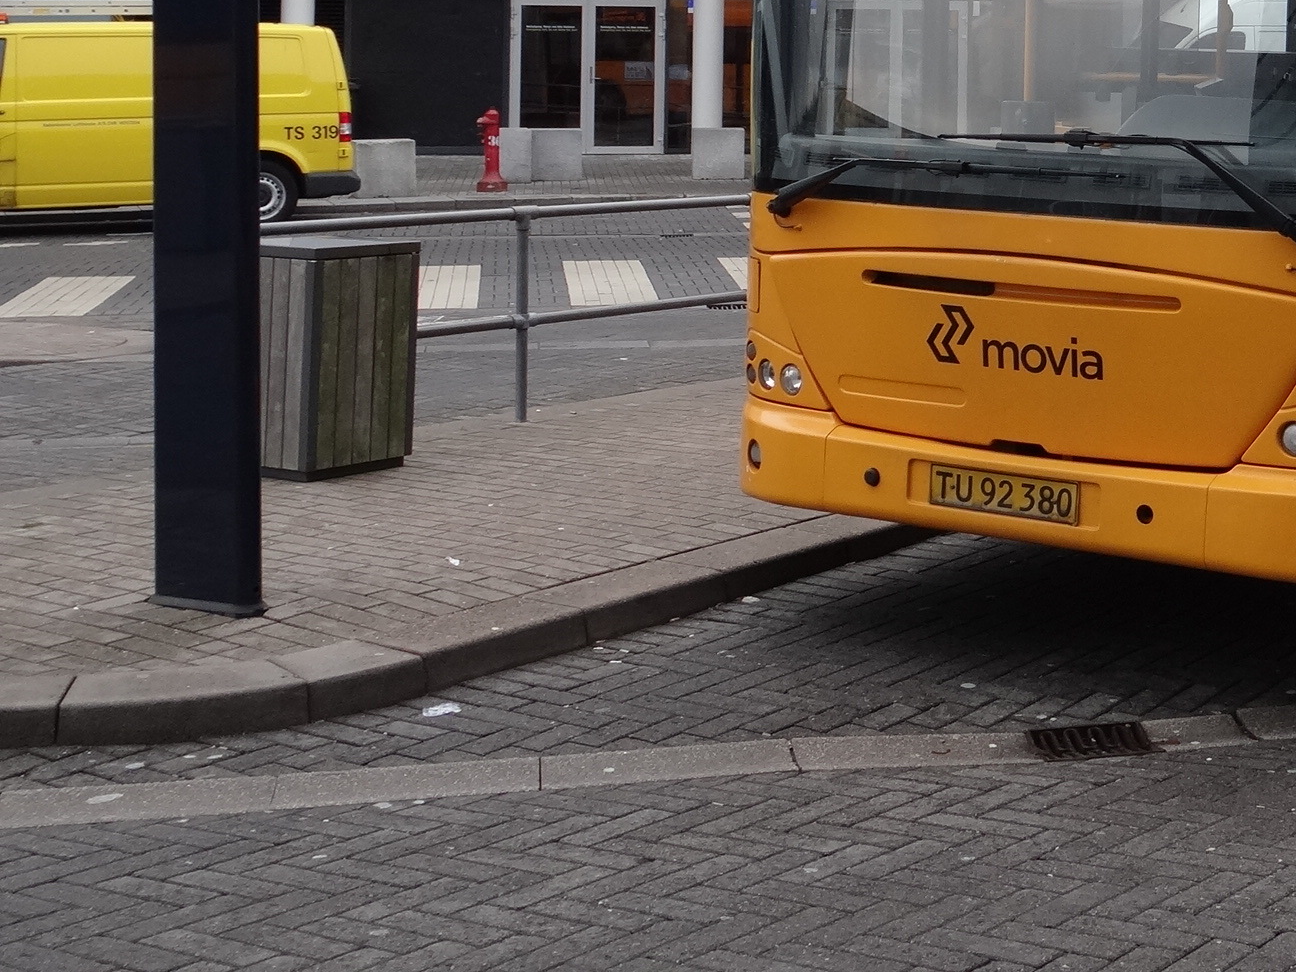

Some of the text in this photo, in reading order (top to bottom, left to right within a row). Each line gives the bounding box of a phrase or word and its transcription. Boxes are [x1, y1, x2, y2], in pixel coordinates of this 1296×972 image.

[284, 124, 339, 140] TS 319
[981, 336, 1104, 381] movia
[935, 470, 1073, 518] TU 92 380
